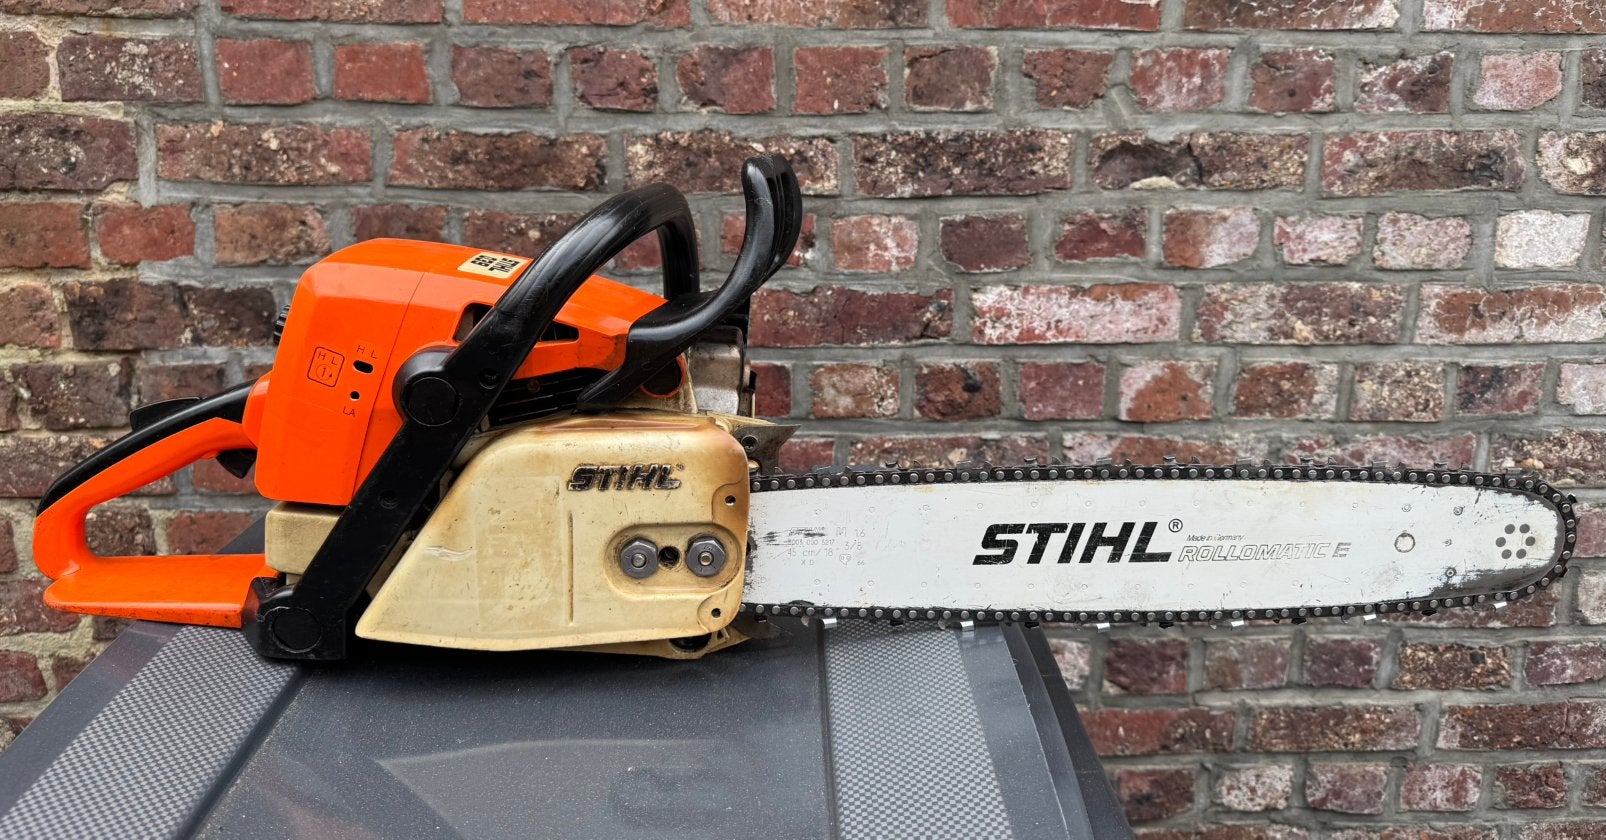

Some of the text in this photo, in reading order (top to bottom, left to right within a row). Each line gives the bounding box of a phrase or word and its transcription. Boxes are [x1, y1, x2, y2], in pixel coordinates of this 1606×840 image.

[488, 257, 521, 273] STIHL
[317, 351, 338, 366] H L
[356, 344, 378, 359] H L
[342, 405, 356, 417] LA
[1186, 534, 1206, 542] Made
[1213, 534, 1245, 543] Germany
[1178, 542, 1352, 562] ROLLOMATIC E
